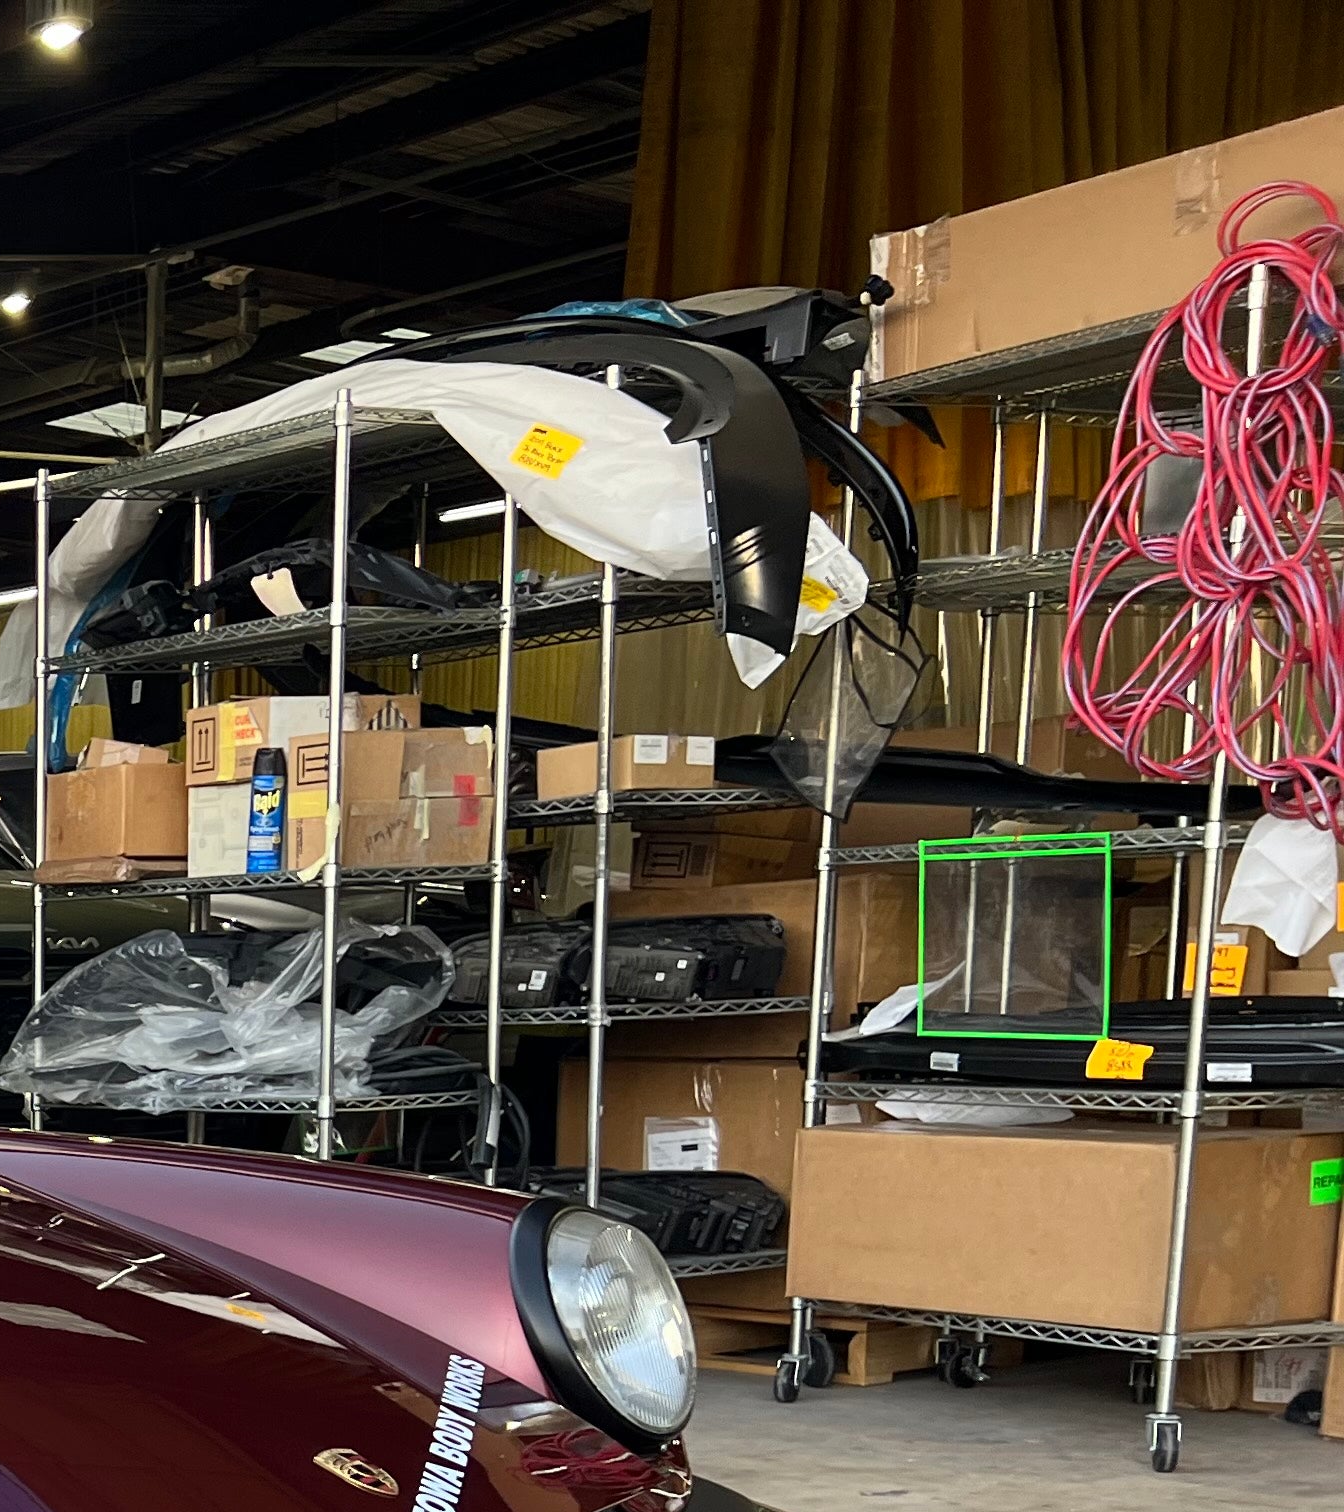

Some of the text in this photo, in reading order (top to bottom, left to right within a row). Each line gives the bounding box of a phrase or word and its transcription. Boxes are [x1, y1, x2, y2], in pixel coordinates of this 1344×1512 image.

[253, 790, 281, 813] Raid
[440, 1354, 486, 1413] WORKS
[429, 1404, 476, 1467] BODY
